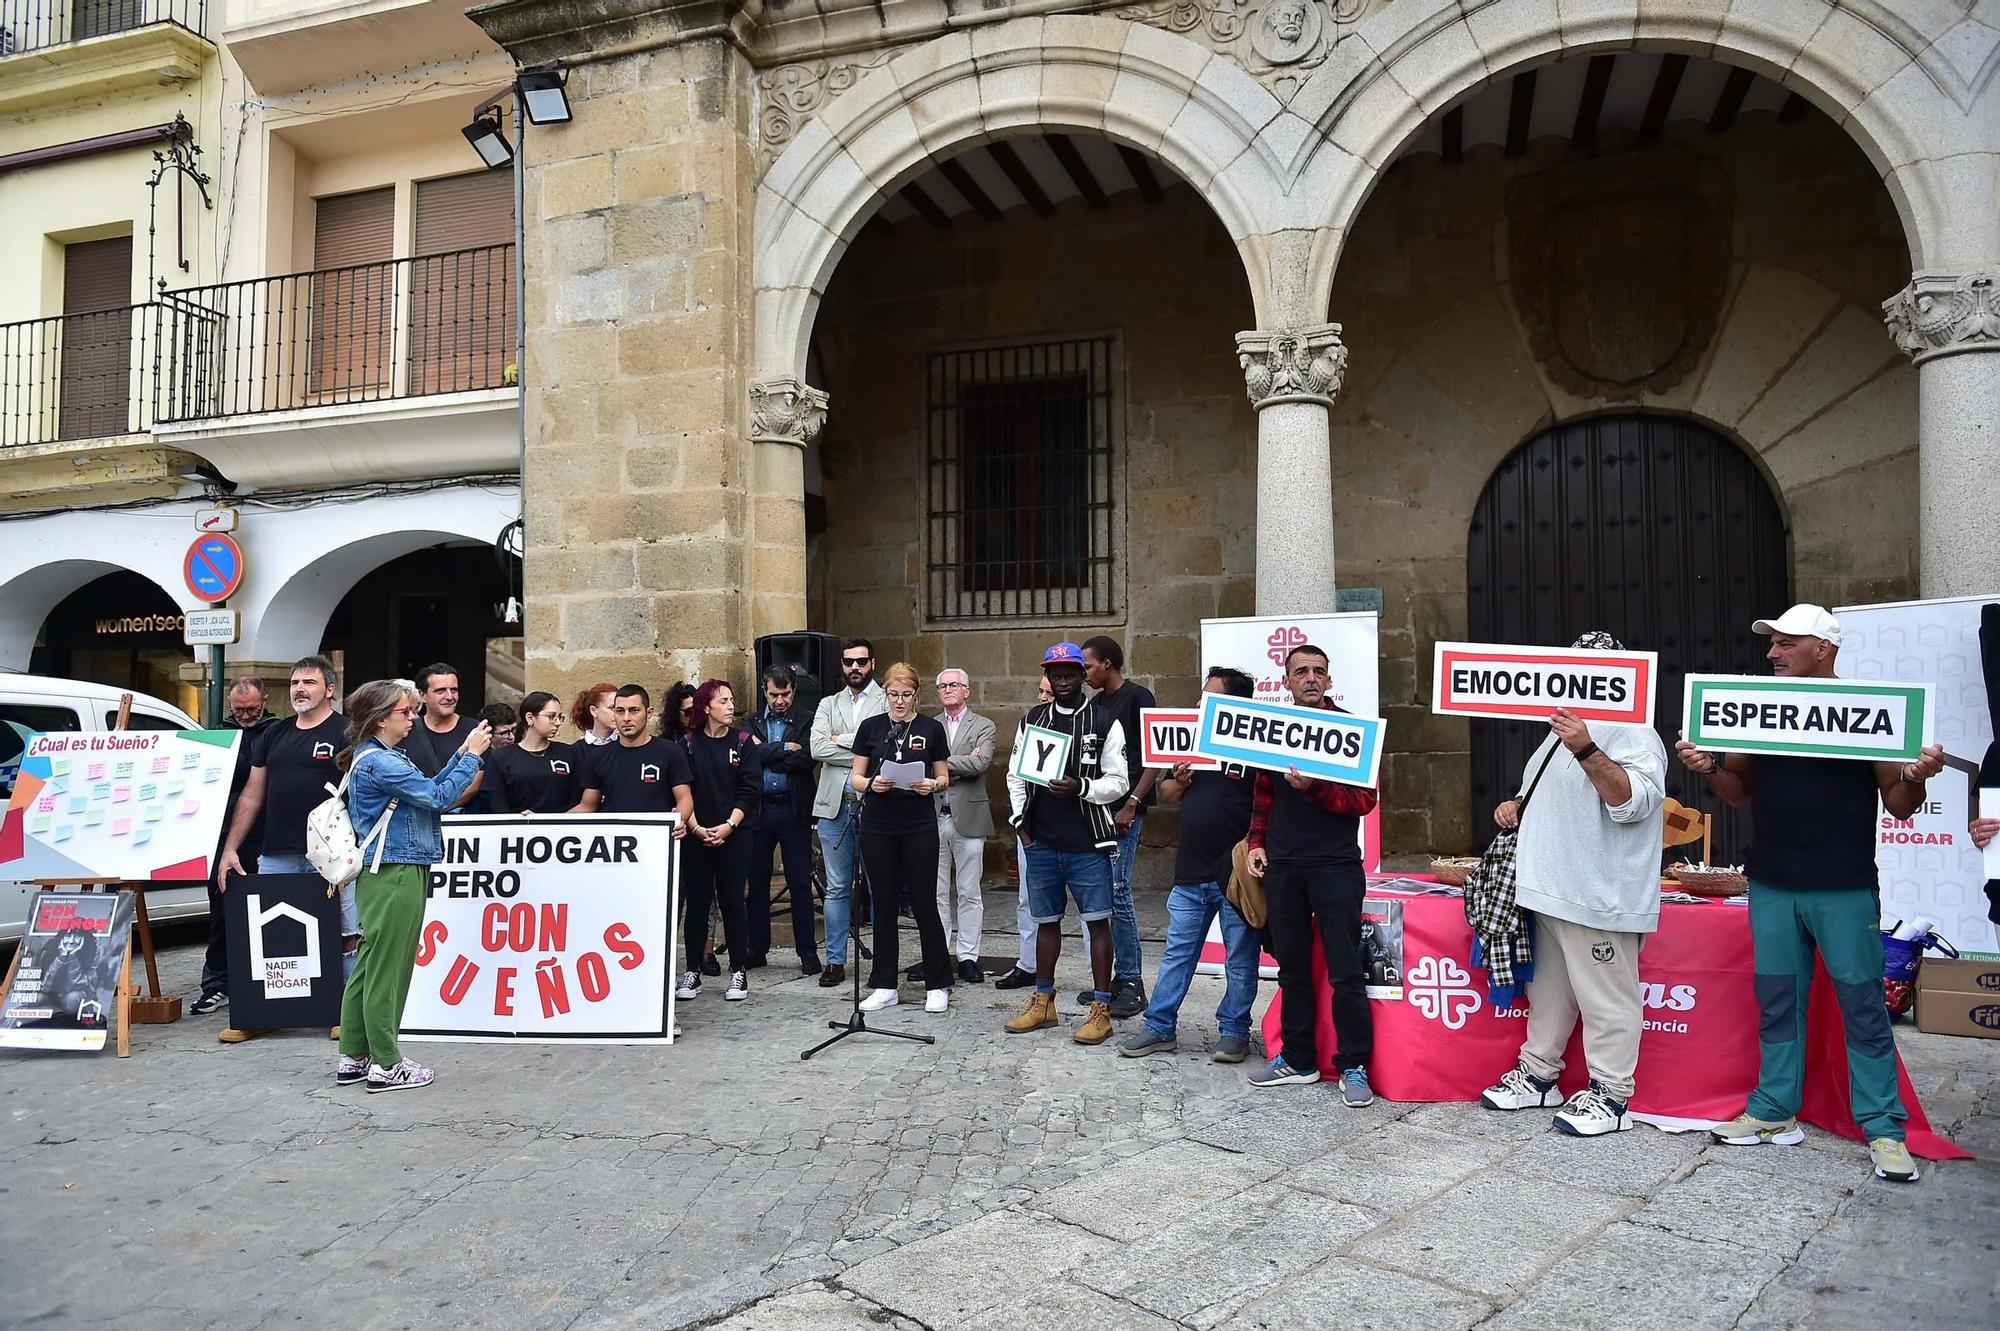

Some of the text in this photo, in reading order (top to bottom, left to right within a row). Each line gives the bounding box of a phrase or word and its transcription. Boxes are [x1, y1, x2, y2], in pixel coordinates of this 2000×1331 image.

[96, 614, 185, 634] women'sec
[1453, 669, 1627, 703] EMOCIONES
[1703, 701, 1894, 736] ESPERANZA
[29, 737, 69, 756] ¿Cual
[71, 740, 87, 750] es
[90, 737, 104, 750] tu
[1152, 726, 1197, 752] VID
[1216, 711, 1361, 758] DERECHOS
[1036, 739, 1056, 772] Y
[1881, 817, 1914, 829] SIN
[441, 835, 639, 864] IN HOGAR
[1881, 832, 1953, 845] HOGAR
[427, 869, 521, 898] PERO
[481, 902, 568, 952] CON
[265, 960, 298, 971] NADIE
[266, 971, 284, 980] SIN
[414, 919, 646, 1019] SUEÑOS
[266, 978, 309, 989] HOGAR
[1639, 982, 1697, 1011] as
[1494, 1005, 1689, 1034] Dioc encia
